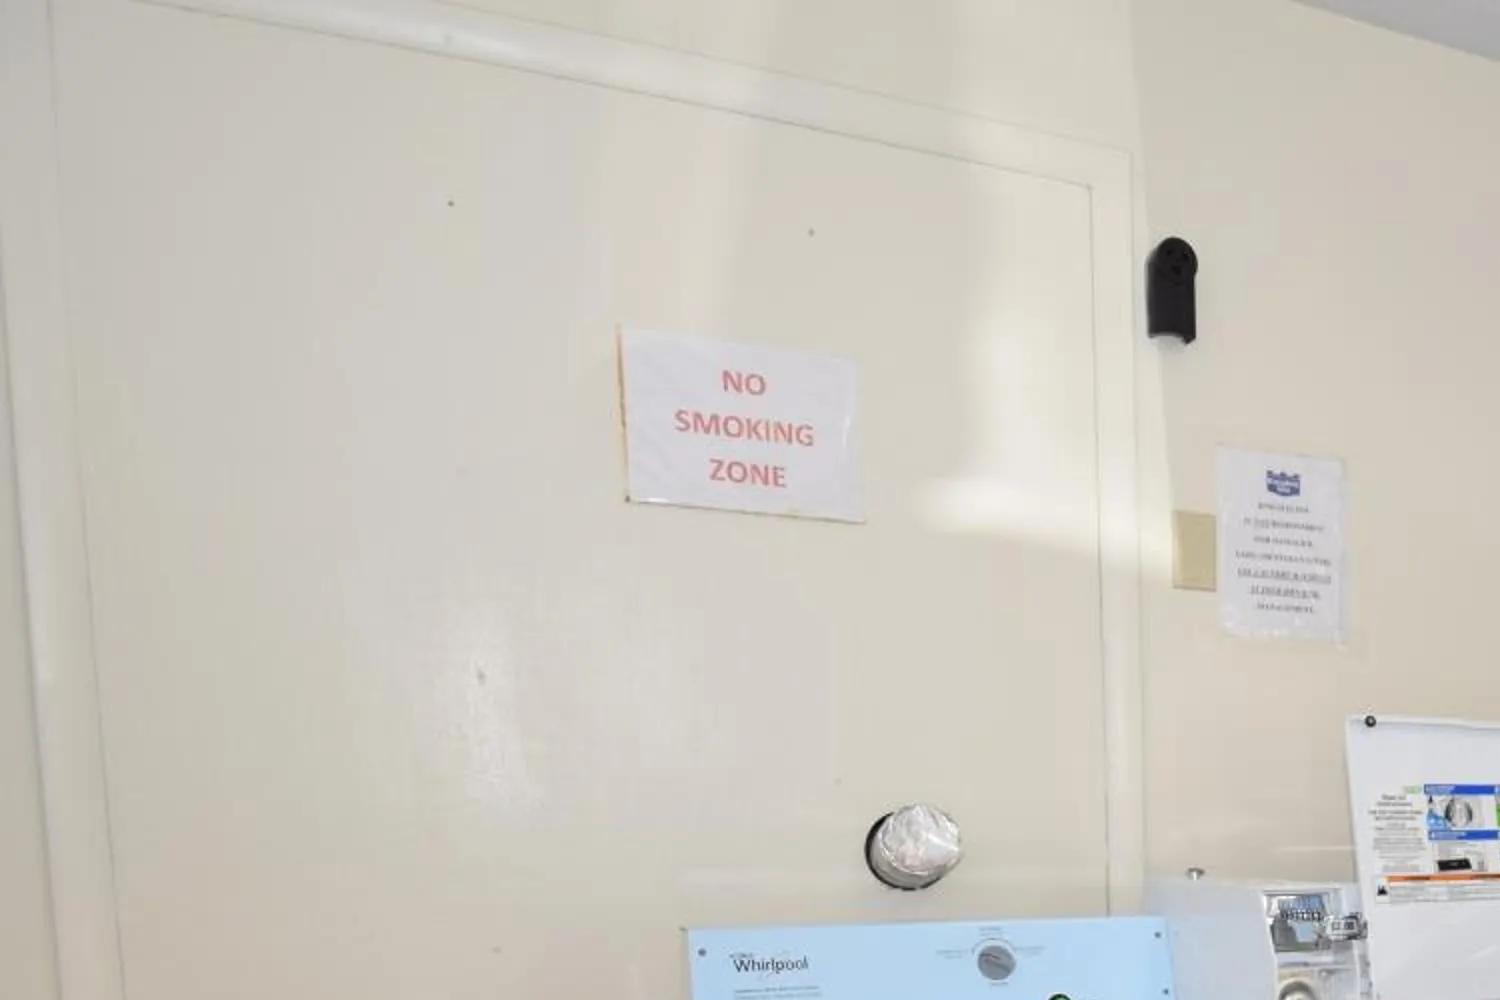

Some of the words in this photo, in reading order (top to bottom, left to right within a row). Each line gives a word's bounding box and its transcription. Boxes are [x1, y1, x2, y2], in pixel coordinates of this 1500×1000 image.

[722, 370, 767, 396] NO
[674, 409, 815, 447] SMOKING
[708, 458, 788, 488] ZONE
[733, 955, 809, 974] Whirlpool
